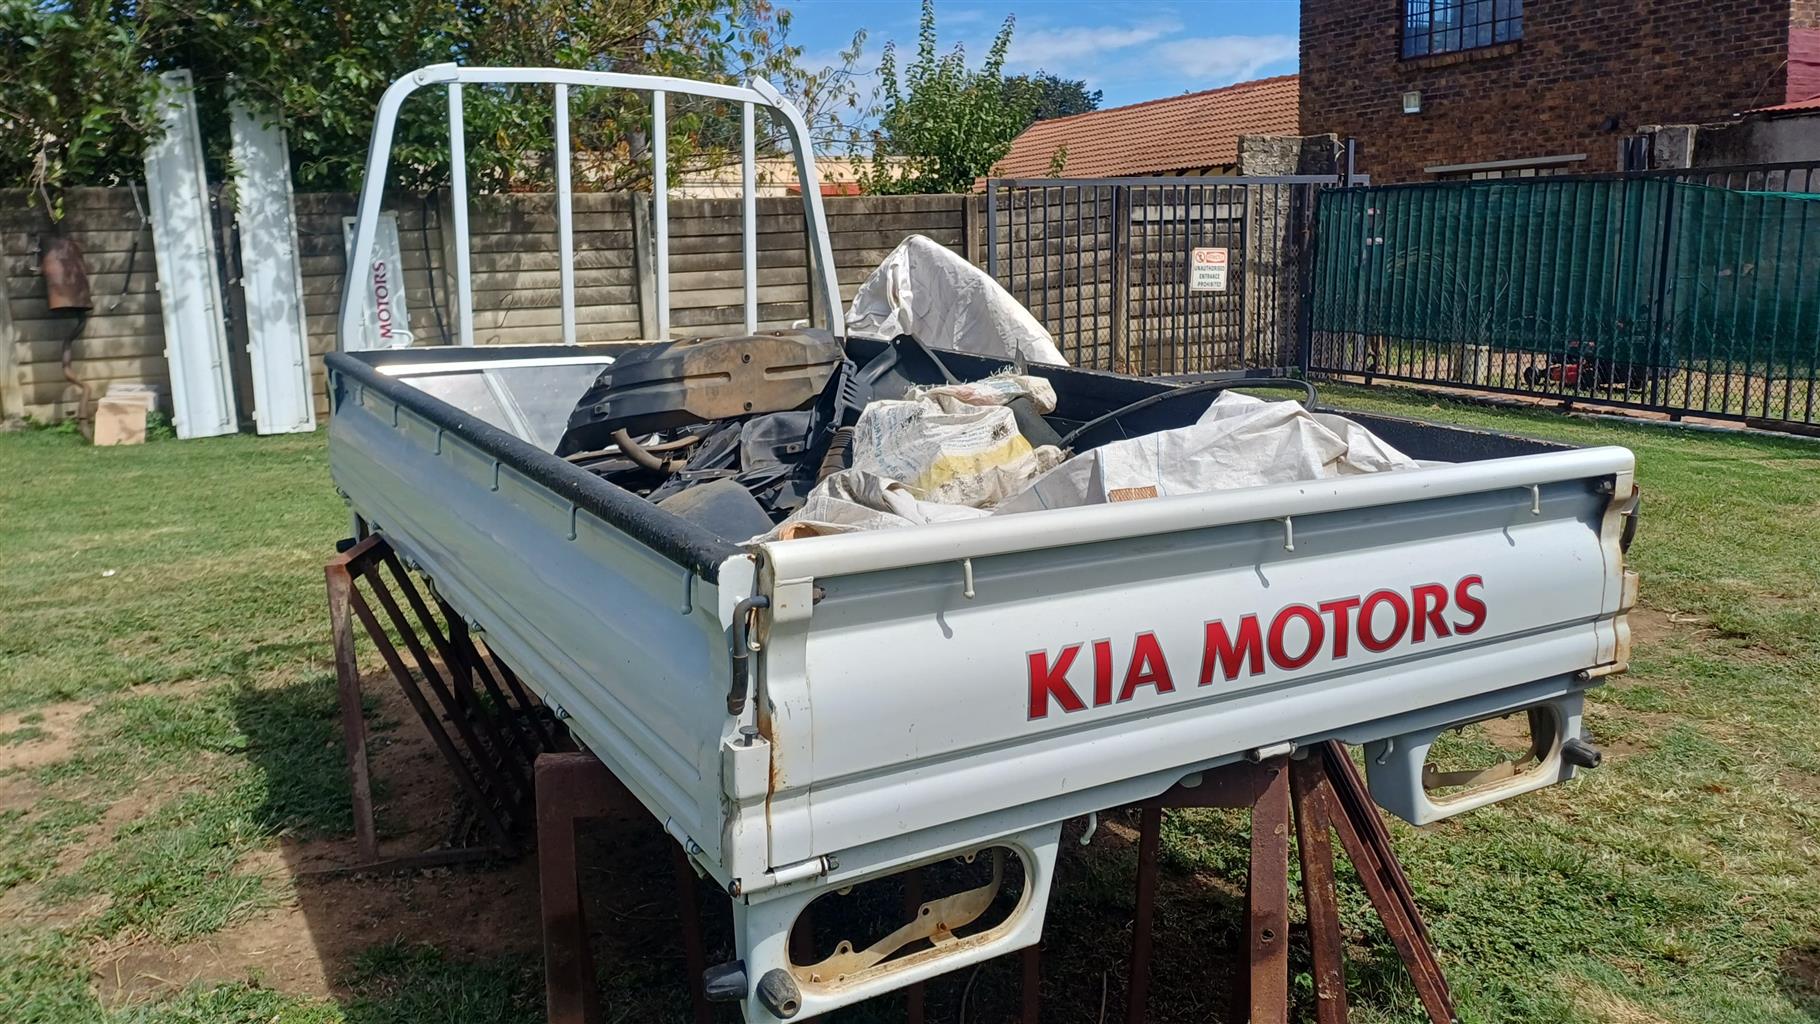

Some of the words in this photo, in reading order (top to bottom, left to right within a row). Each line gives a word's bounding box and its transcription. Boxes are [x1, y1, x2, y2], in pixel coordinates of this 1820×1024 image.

[372, 261, 393, 339] MOTORS
[1026, 630, 1176, 722] KIA
[1198, 573, 1488, 687] MOTORS
